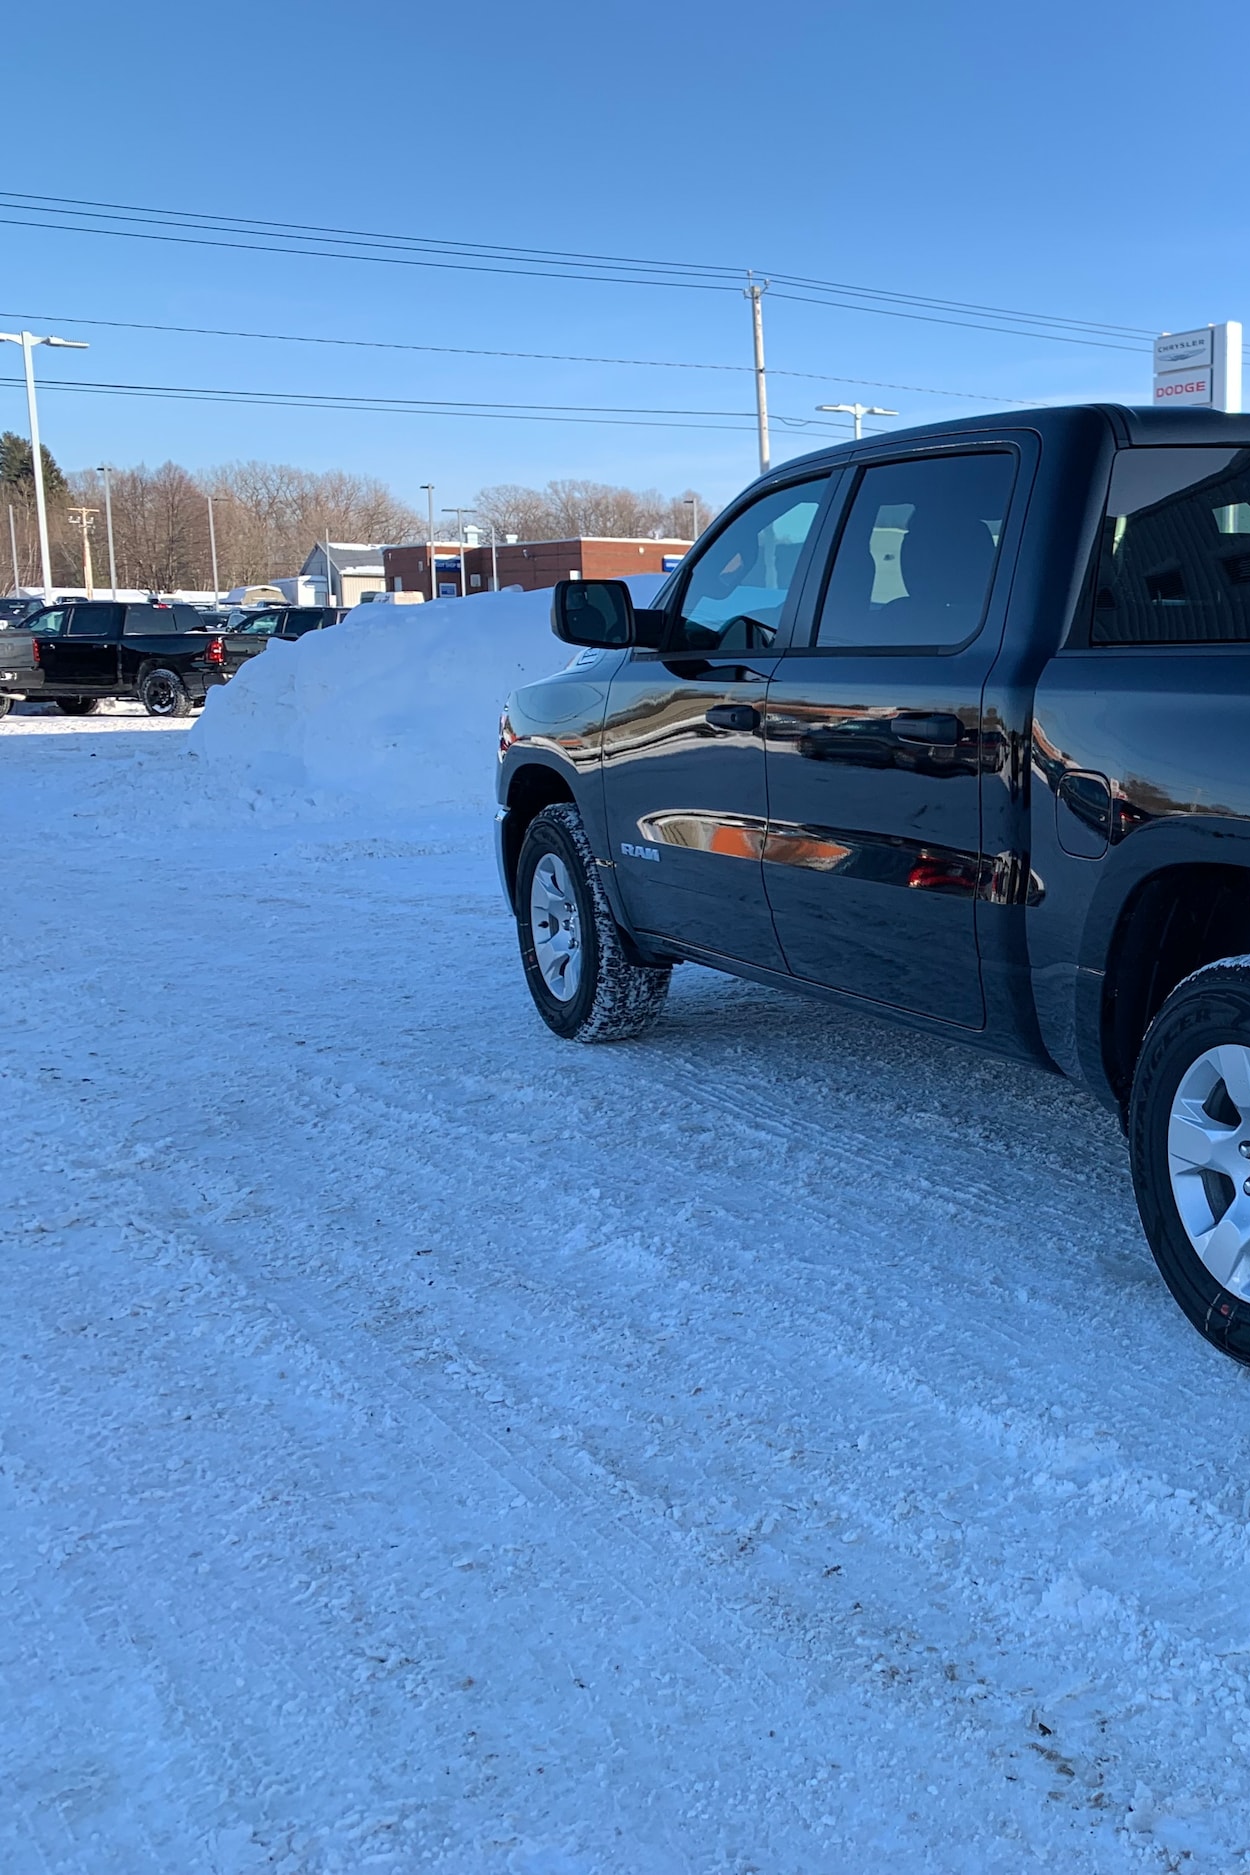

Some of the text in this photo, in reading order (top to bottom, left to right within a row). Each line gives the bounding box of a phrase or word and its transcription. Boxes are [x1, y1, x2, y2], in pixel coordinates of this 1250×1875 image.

[1157, 339, 1205, 353] CHRYSLER
[1156, 381, 1206, 398] DODGE
[621, 842, 660, 862] RAM
